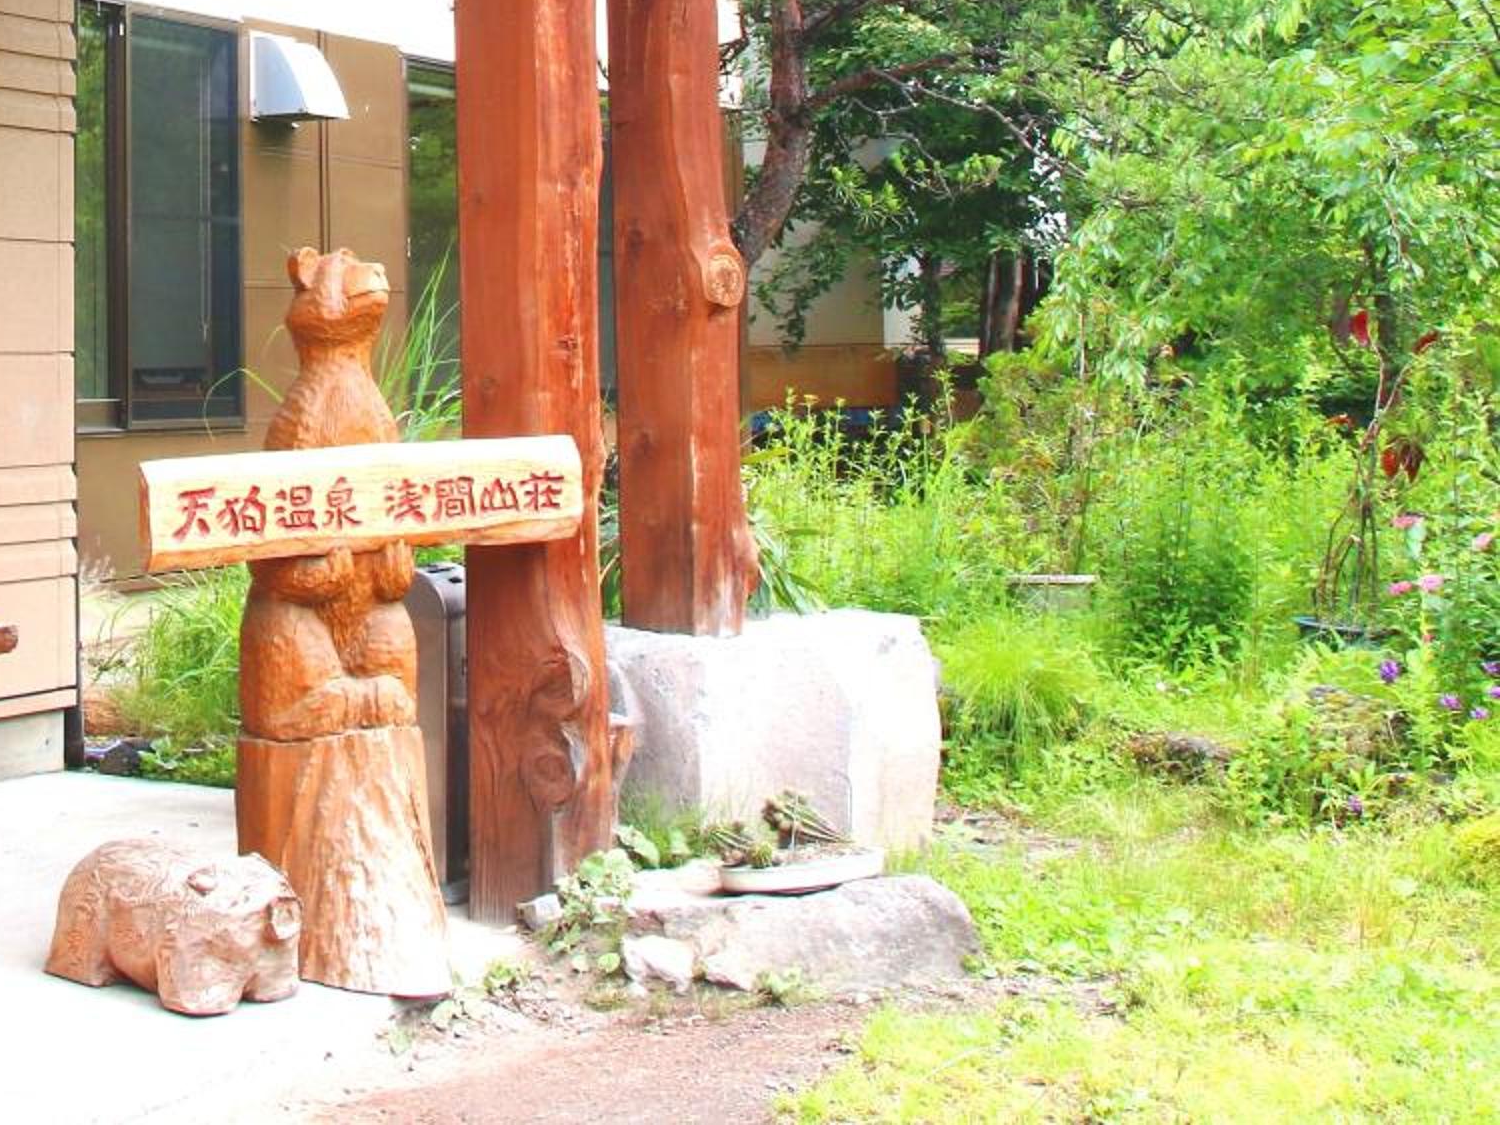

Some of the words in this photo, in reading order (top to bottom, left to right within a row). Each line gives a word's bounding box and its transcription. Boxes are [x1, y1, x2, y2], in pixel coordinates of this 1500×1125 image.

[172, 476, 364, 542] 天狗温泉
[384, 470, 565, 524] 浅間山荘
